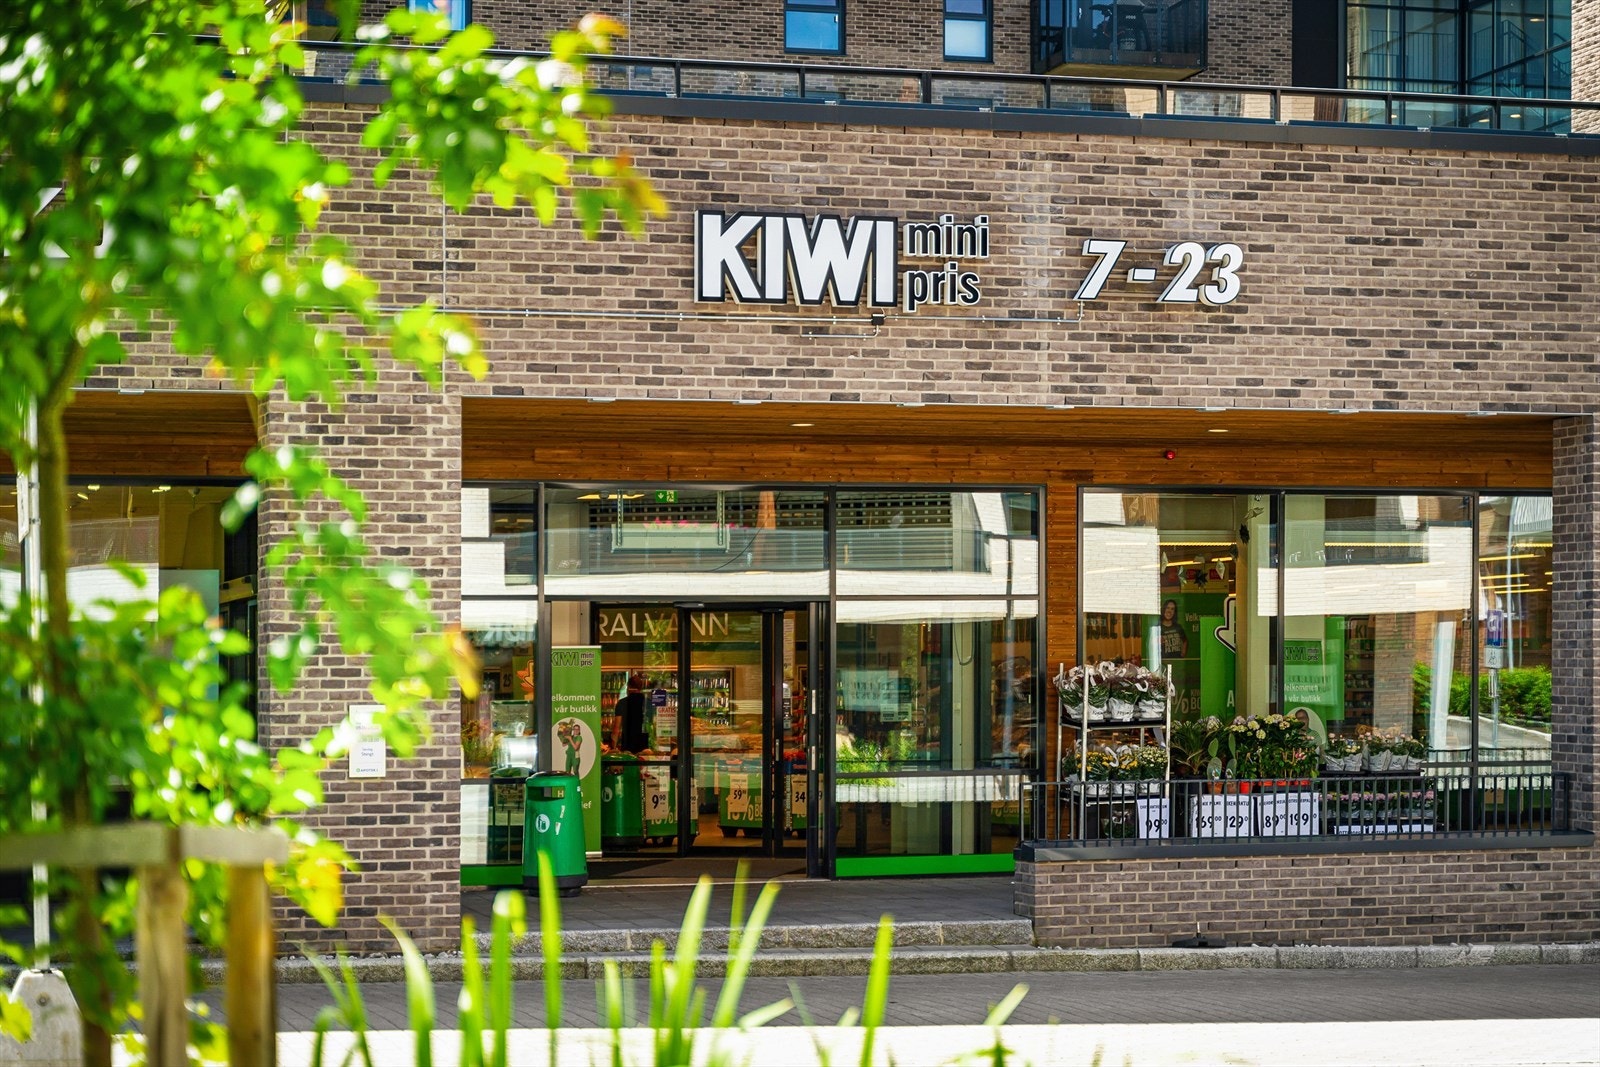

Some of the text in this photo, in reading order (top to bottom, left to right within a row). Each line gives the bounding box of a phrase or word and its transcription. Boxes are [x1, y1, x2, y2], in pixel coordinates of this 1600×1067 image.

[696, 209, 898, 306] KIWI
[903, 214, 990, 258] mini
[903, 260, 981, 313] pris
[1073, 238, 1244, 306] 7 - 23
[580, 659, 593, 667] pris
[554, 705, 597, 713] vår butikk
